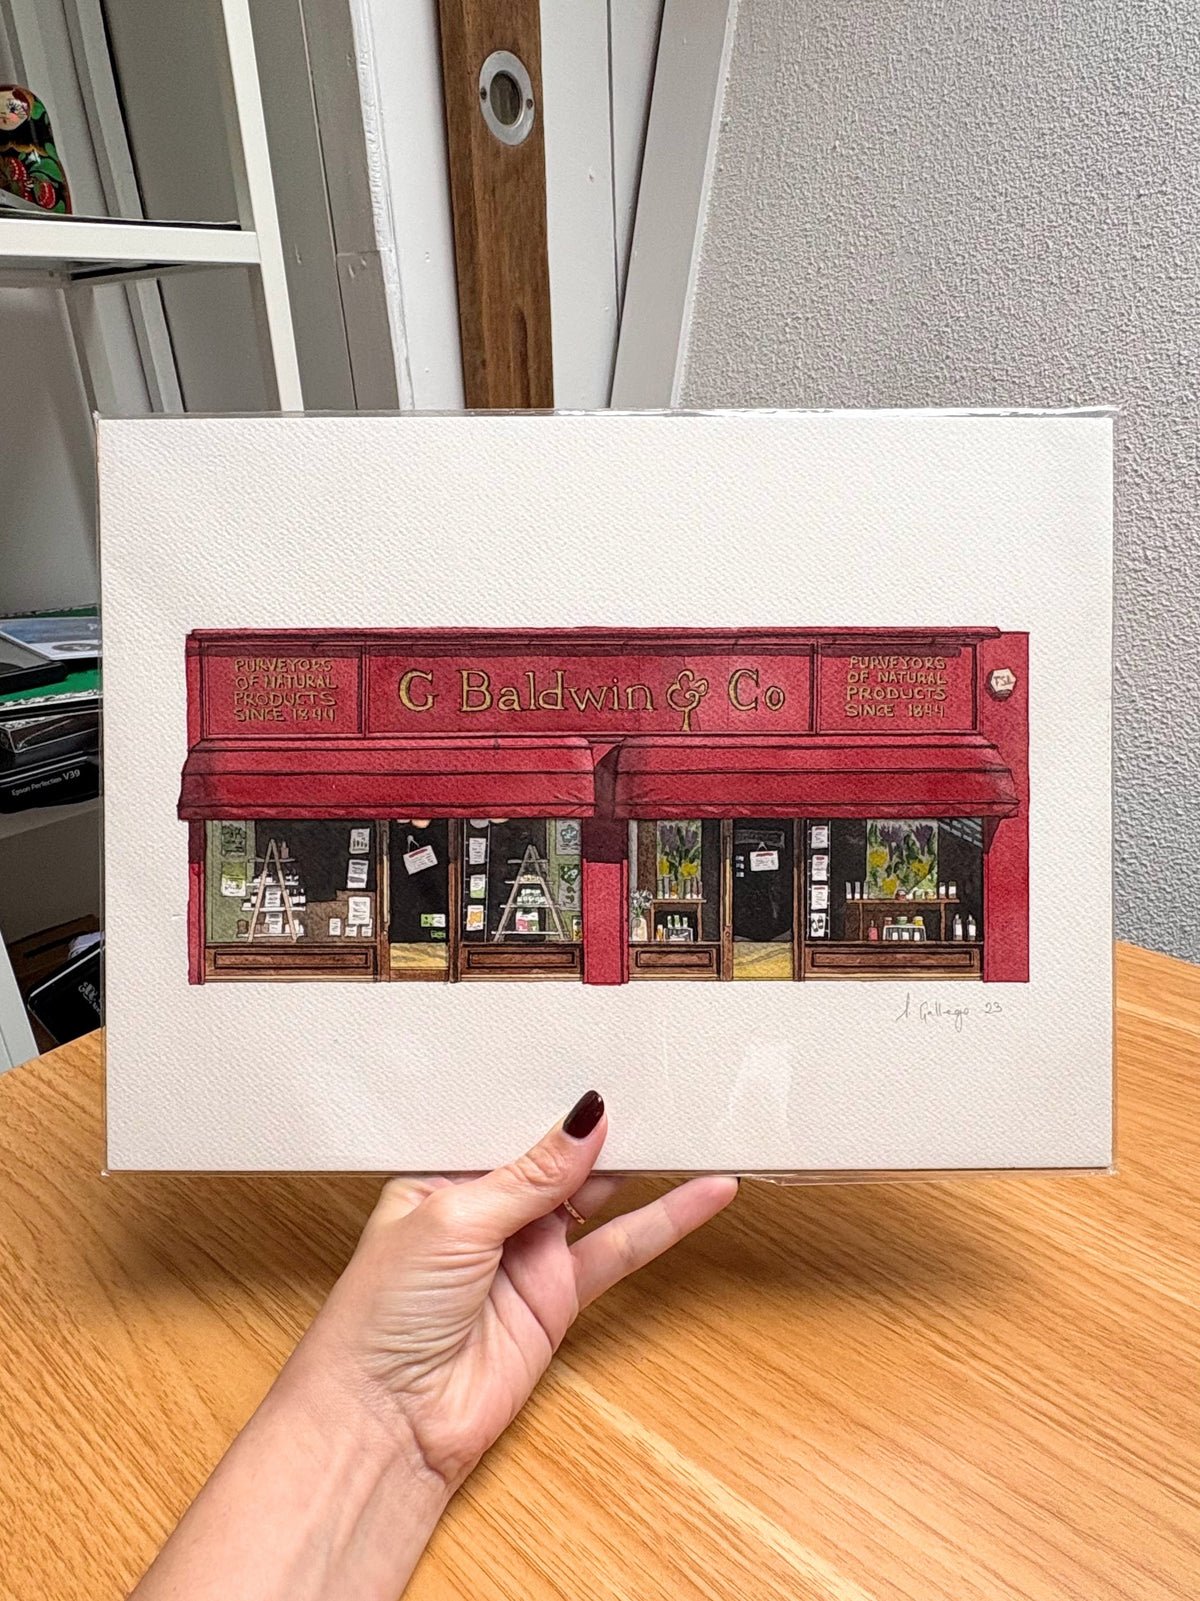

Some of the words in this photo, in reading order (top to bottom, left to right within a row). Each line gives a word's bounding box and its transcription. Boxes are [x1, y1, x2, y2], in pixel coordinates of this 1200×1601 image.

[234, 658, 333, 673] PURVEYORS
[848, 655, 946, 670] PURVEYORS
[235, 675, 260, 691] OF
[263, 673, 338, 689] NATURAL
[847, 670, 869, 684] OF
[878, 671, 947, 685] NATURAL
[398, 669, 439, 712] G
[456, 669, 657, 713] Baldwin
[728, 668, 785, 712] Co
[846, 685, 947, 701] PRODUCTS
[234, 691, 337, 708] PRODUCTS
[233, 707, 286, 722] SINCE
[291, 707, 335, 722] 1844
[844, 703, 895, 718] SINCE
[908, 703, 945, 718] 1844
[11, 786, 31, 796] Epson
[31, 777, 62, 791] Perfection
[62, 769, 81, 780] V39
[984, 1001, 1003, 1014] 23
